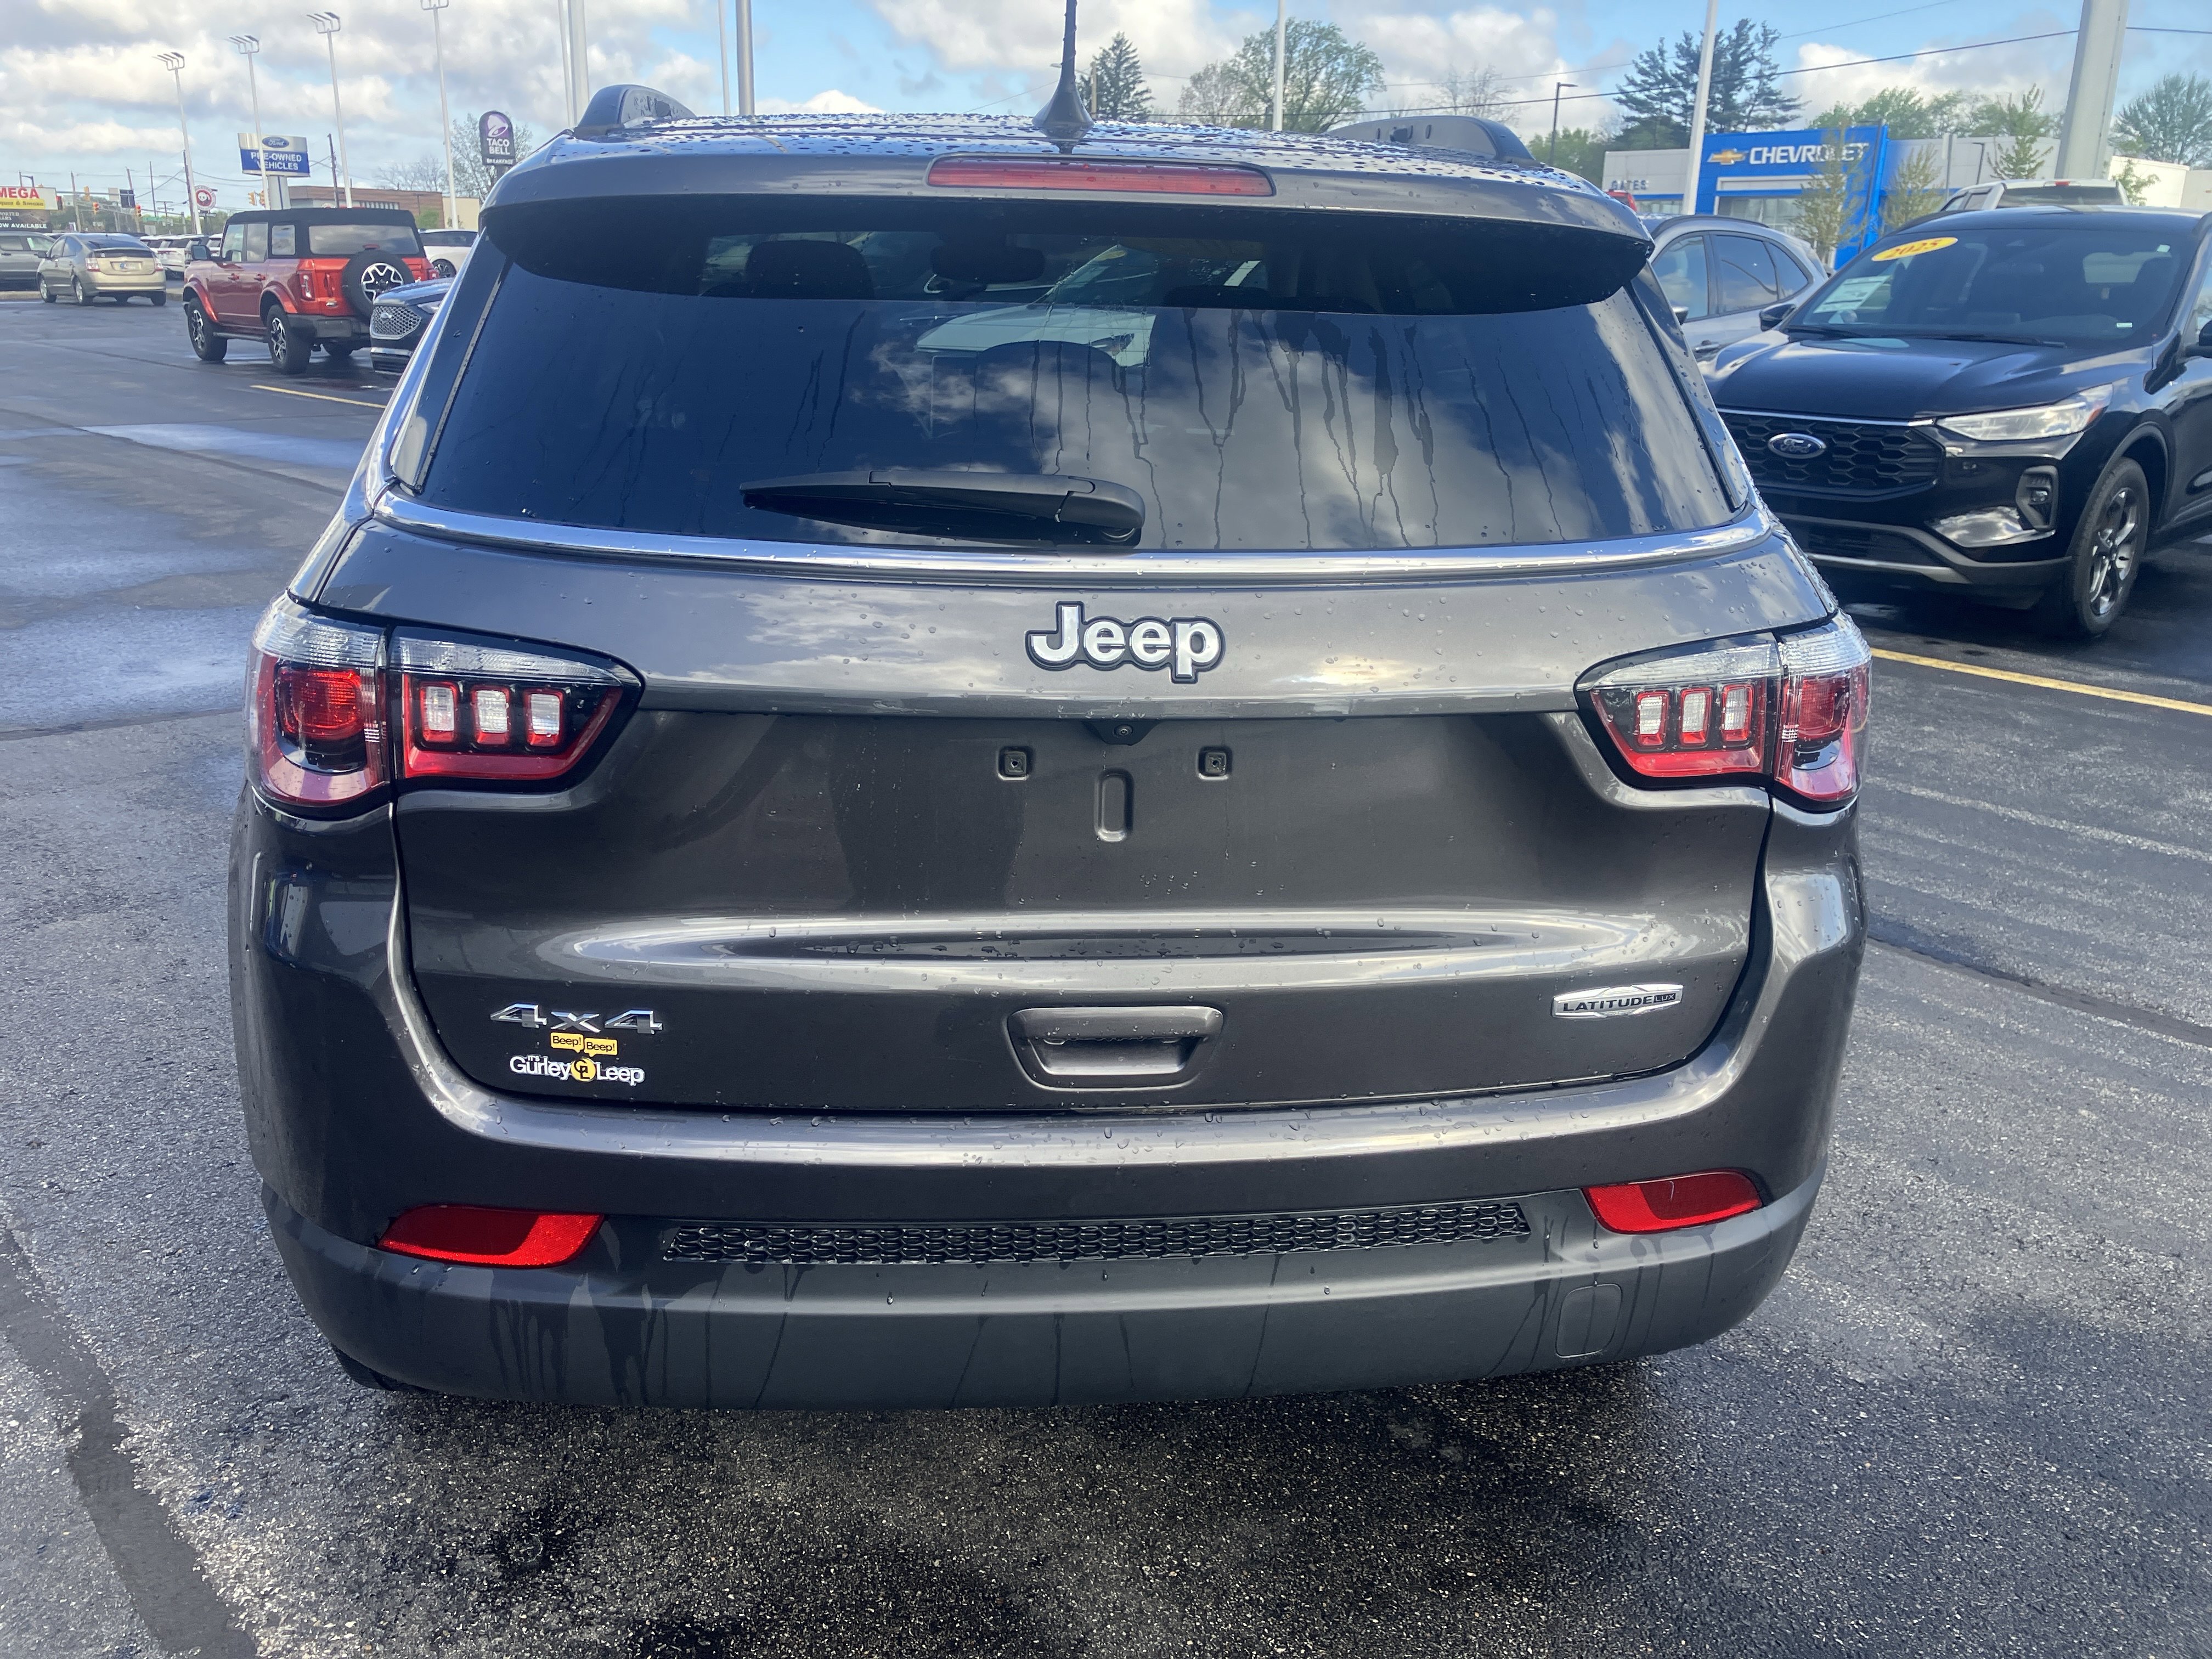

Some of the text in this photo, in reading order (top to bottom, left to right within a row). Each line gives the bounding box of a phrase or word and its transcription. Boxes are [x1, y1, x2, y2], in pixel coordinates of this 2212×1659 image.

[487, 138, 510, 147] TACO
[489, 146, 510, 155] BELL
[1611, 180, 1646, 190] GATES
[1780, 438, 1811, 453] Ford
[1029, 604, 1222, 679] Jeep
[1564, 994, 1675, 1011] LATITUDE LUX
[552, 1036, 615, 1052] Beep! Beep!
[510, 1056, 572, 1080] Gurley
[596, 1062, 645, 1086] Leep
